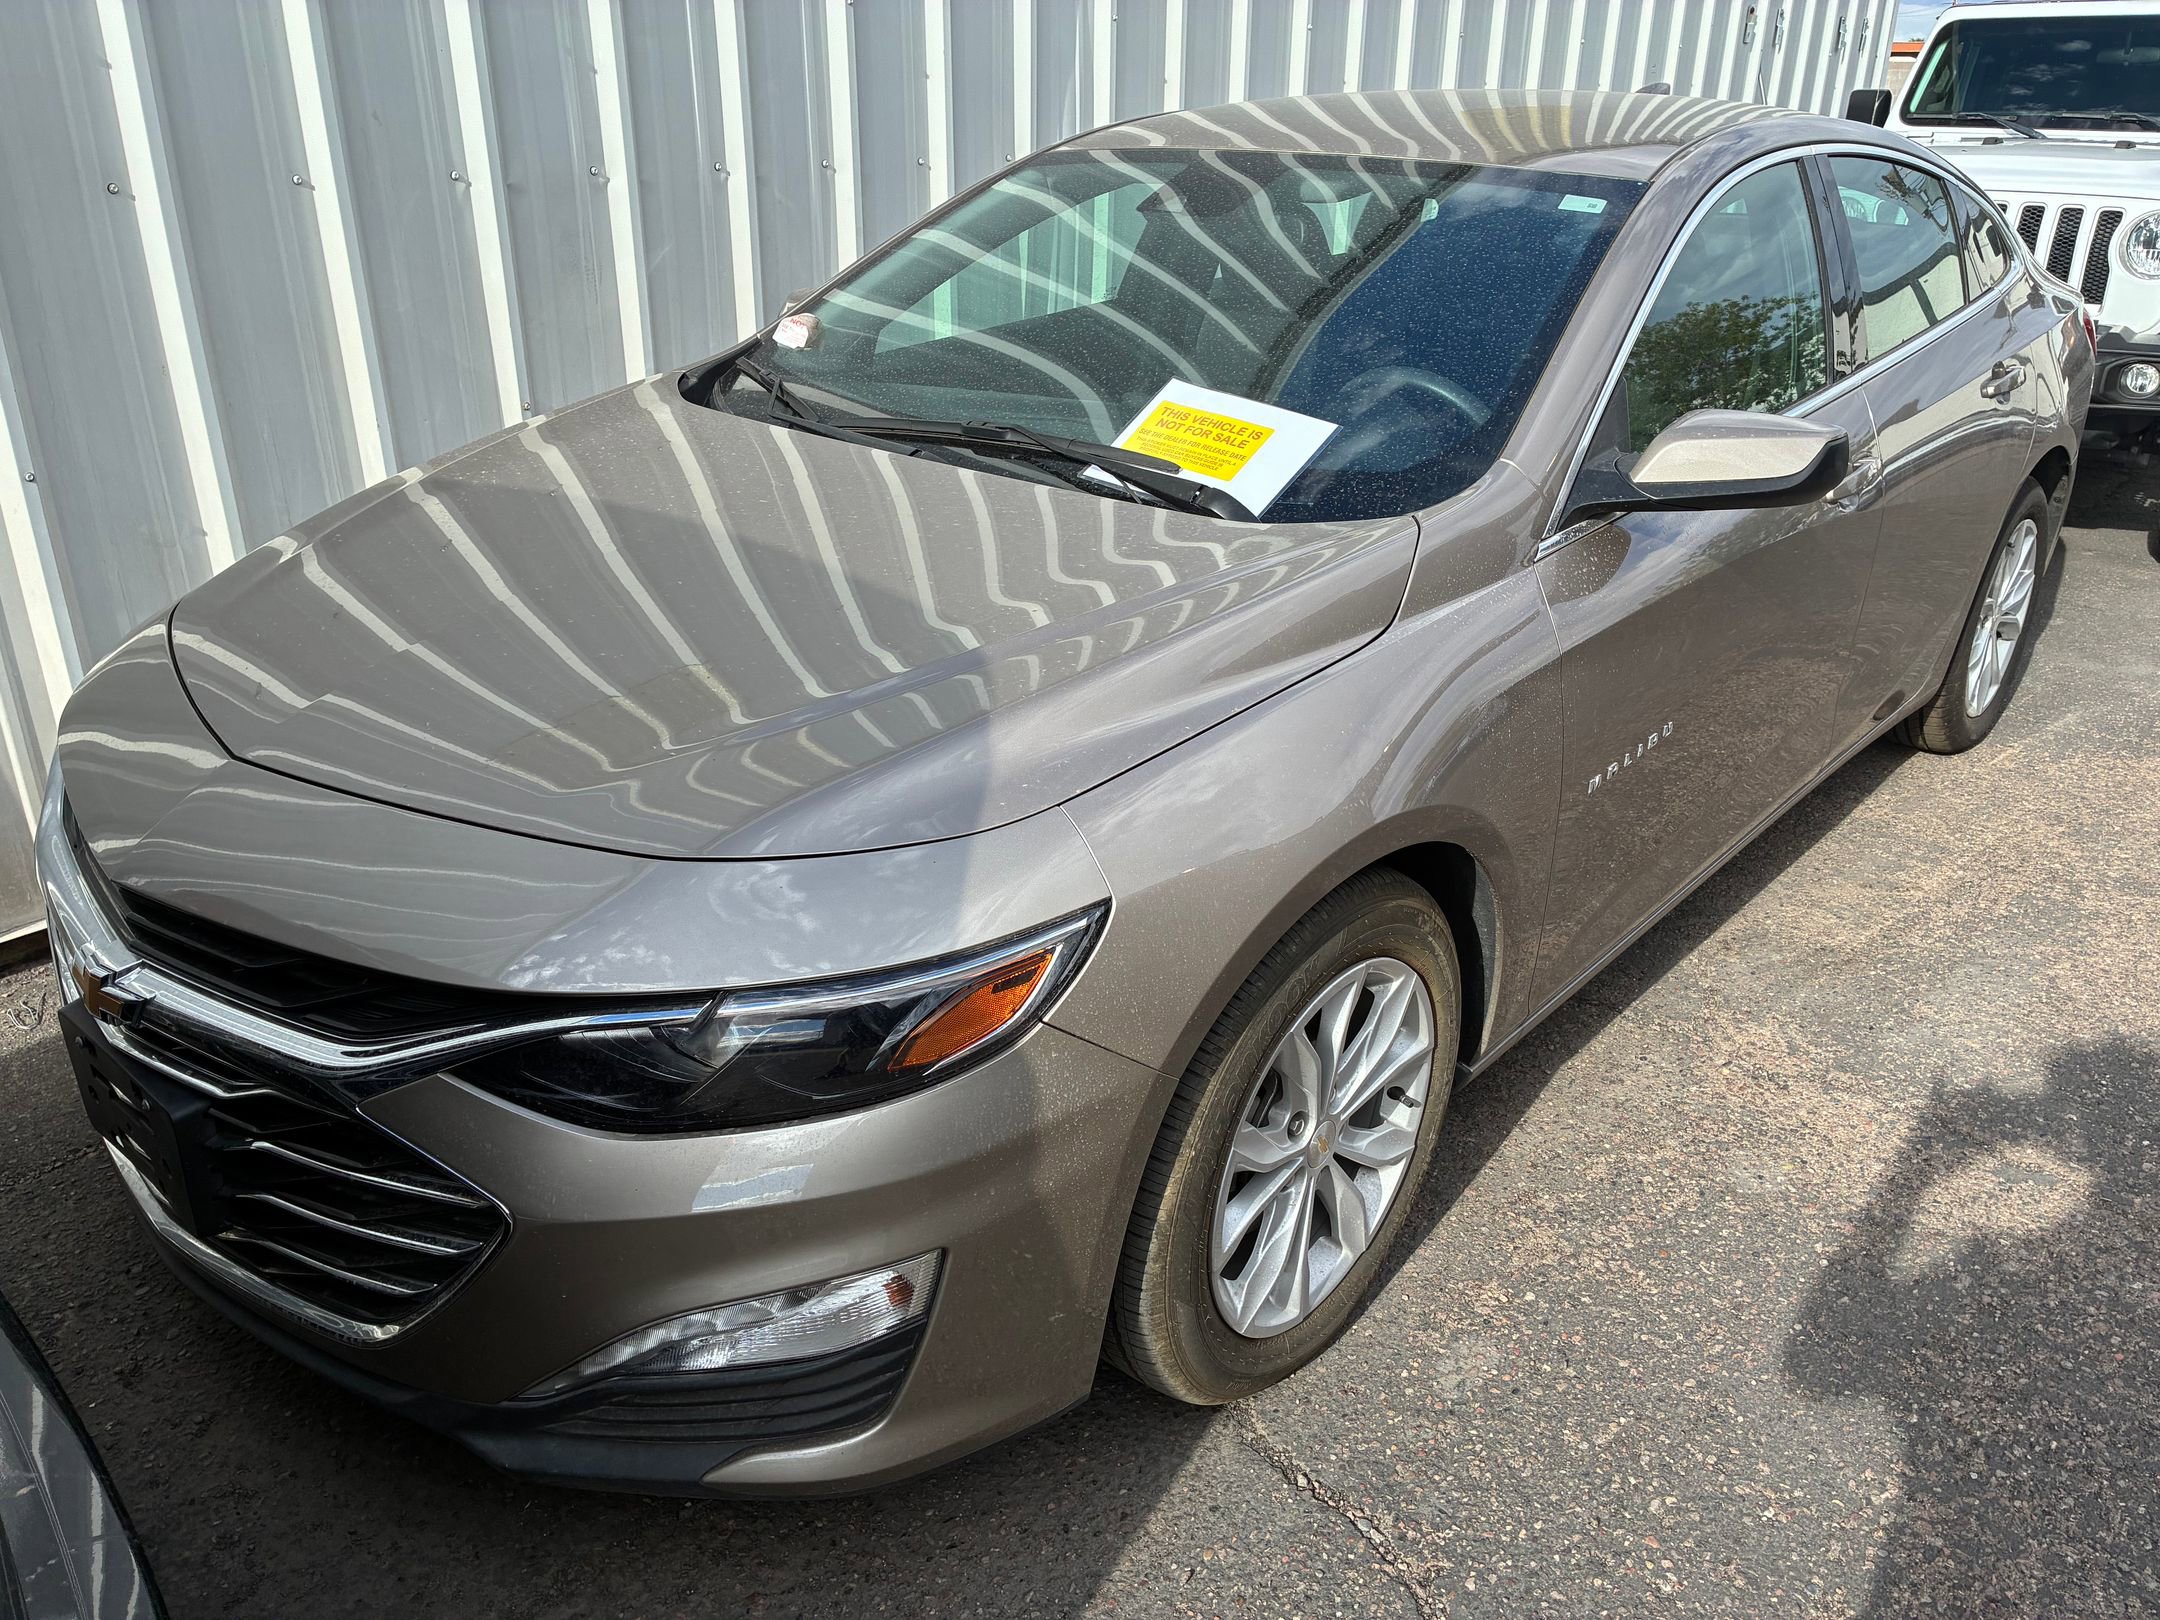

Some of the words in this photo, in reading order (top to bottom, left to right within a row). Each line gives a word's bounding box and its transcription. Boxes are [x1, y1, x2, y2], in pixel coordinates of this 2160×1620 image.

[1155, 417, 1186, 431] NOT
[1183, 425, 1213, 439] FOR
[1212, 432, 1250, 449] SALE
[1161, 406, 1191, 421] THIS
[1192, 415, 1249, 436] VEHICLE
[1247, 429, 1264, 441] IS
[1139, 428, 1152, 436] SEE
[1151, 431, 1164, 439] THE
[1163, 434, 1188, 445] DEALER
[1187, 440, 1201, 448] FOR
[1201, 444, 1230, 456] RELEASE
[1229, 452, 1247, 461] DATE
[1587, 721, 1673, 795] MALIBU
